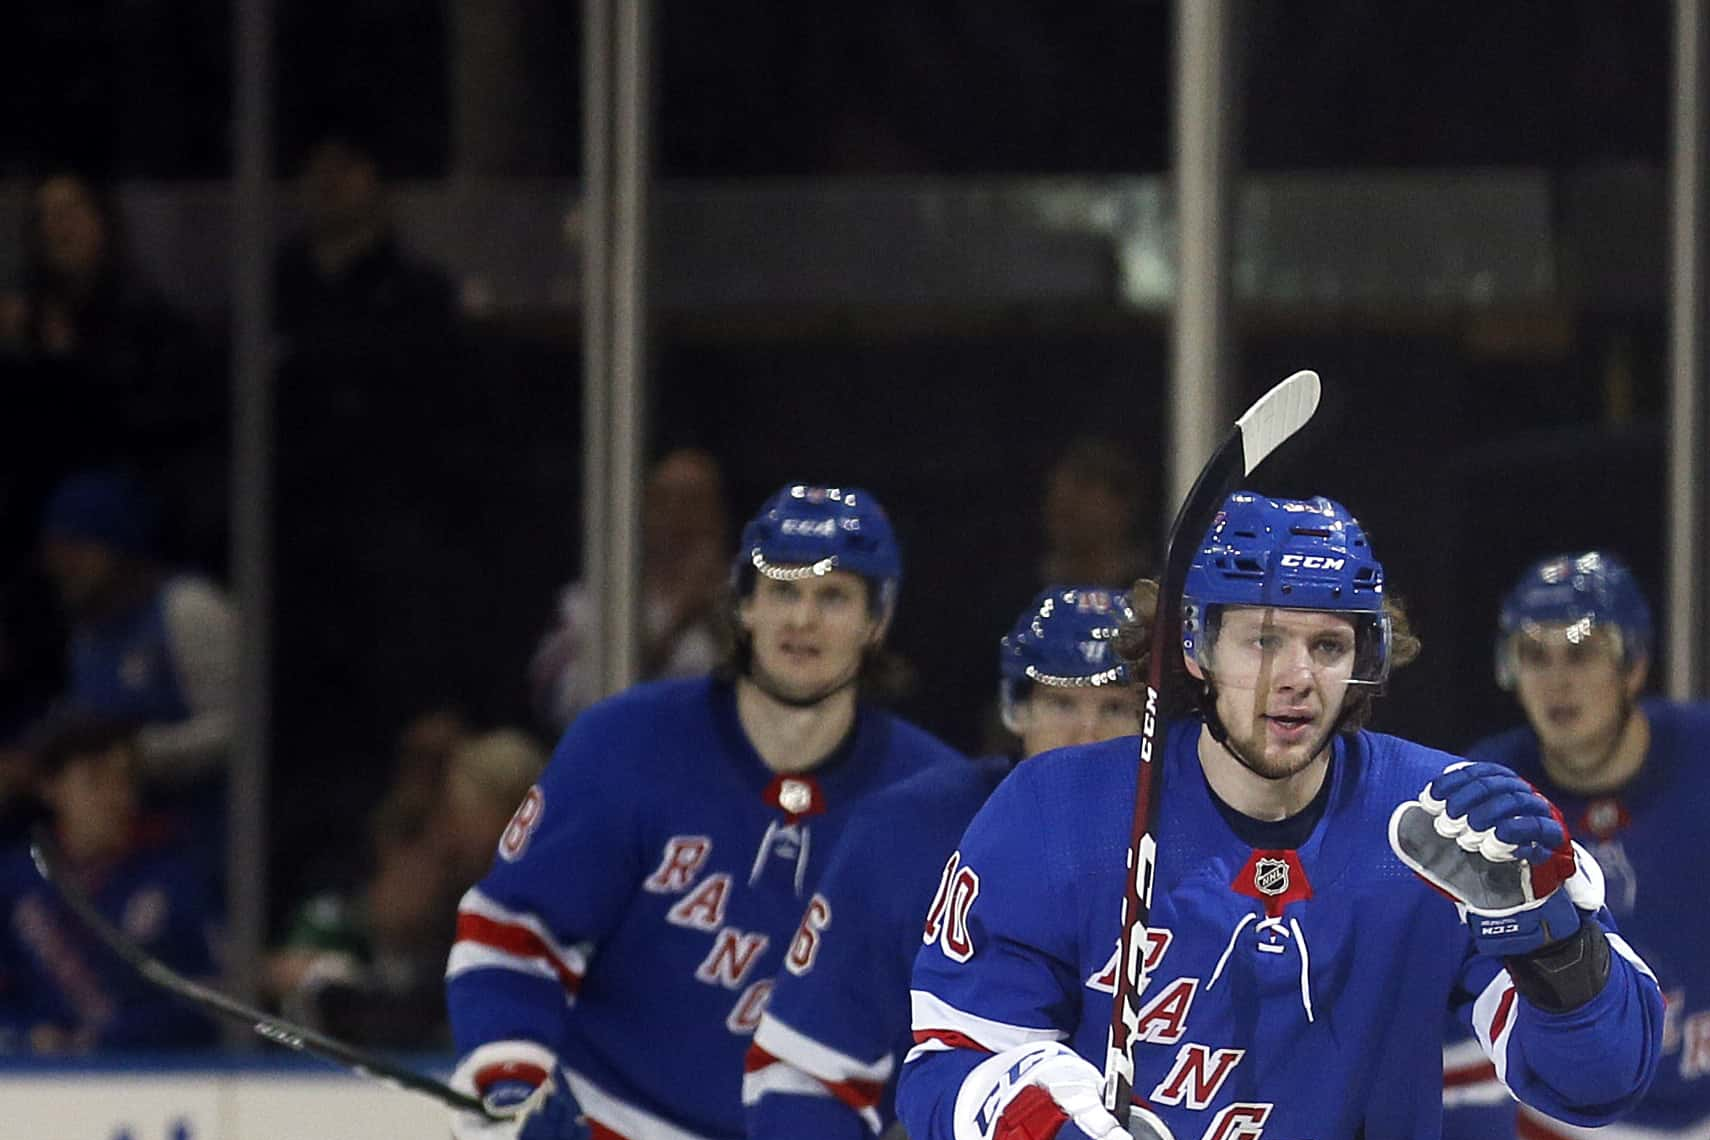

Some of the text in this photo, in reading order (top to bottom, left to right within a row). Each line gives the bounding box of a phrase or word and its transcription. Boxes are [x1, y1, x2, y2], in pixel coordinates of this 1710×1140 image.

[1281, 555, 1344, 570] CCM
[1141, 686, 1158, 762] CCM
[1262, 869, 1283, 887] NHL
[923, 850, 980, 963] 10
[1482, 924, 1519, 935] CCM
